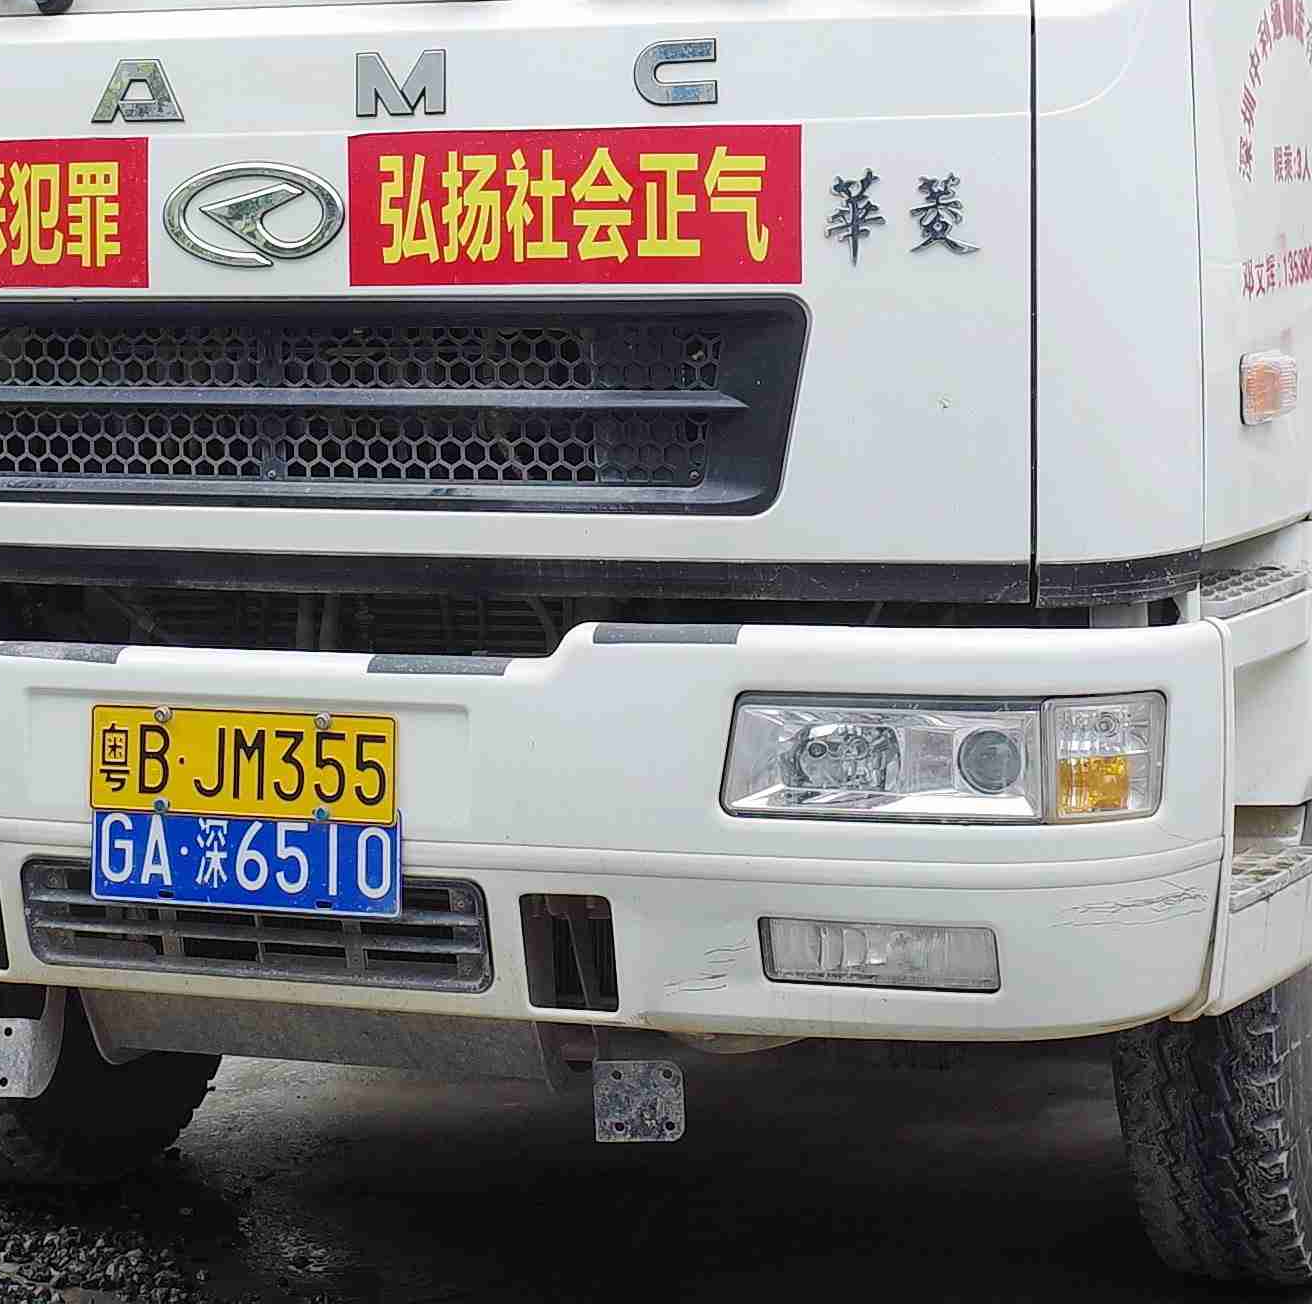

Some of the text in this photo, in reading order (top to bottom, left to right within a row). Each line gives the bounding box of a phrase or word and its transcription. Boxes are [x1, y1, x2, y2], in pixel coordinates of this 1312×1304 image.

[379, 145, 771, 265] 弘扬社会正气
[826, 168, 982, 267] 華菱
[99, 722, 387, 806] 粤B·JM355
[100, 812, 392, 900] GA·深6510
